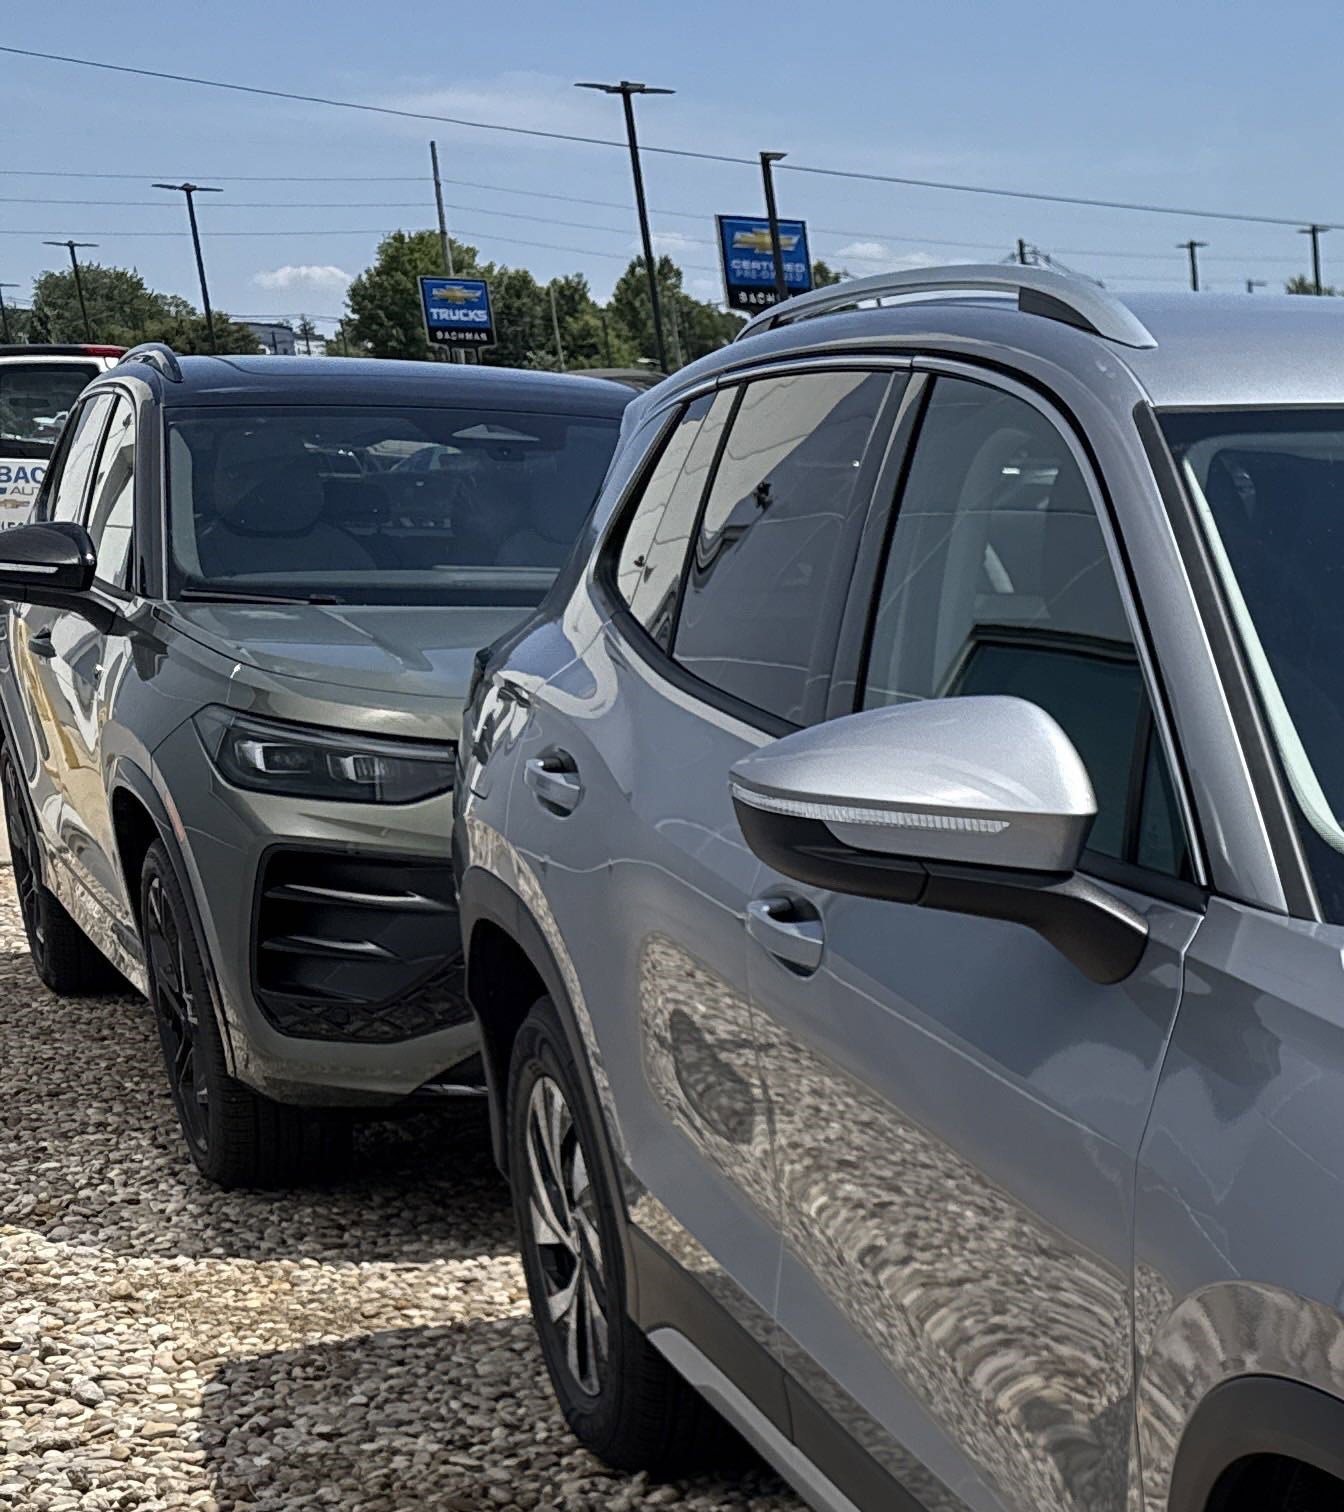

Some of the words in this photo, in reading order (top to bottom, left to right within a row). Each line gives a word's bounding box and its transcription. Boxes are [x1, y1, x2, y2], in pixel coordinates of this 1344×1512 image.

[731, 260, 806, 273] CERTIED
[735, 269, 803, 282] PRE-OED
[738, 291, 782, 305] BACH
[430, 308, 488, 322] TRUCKS
